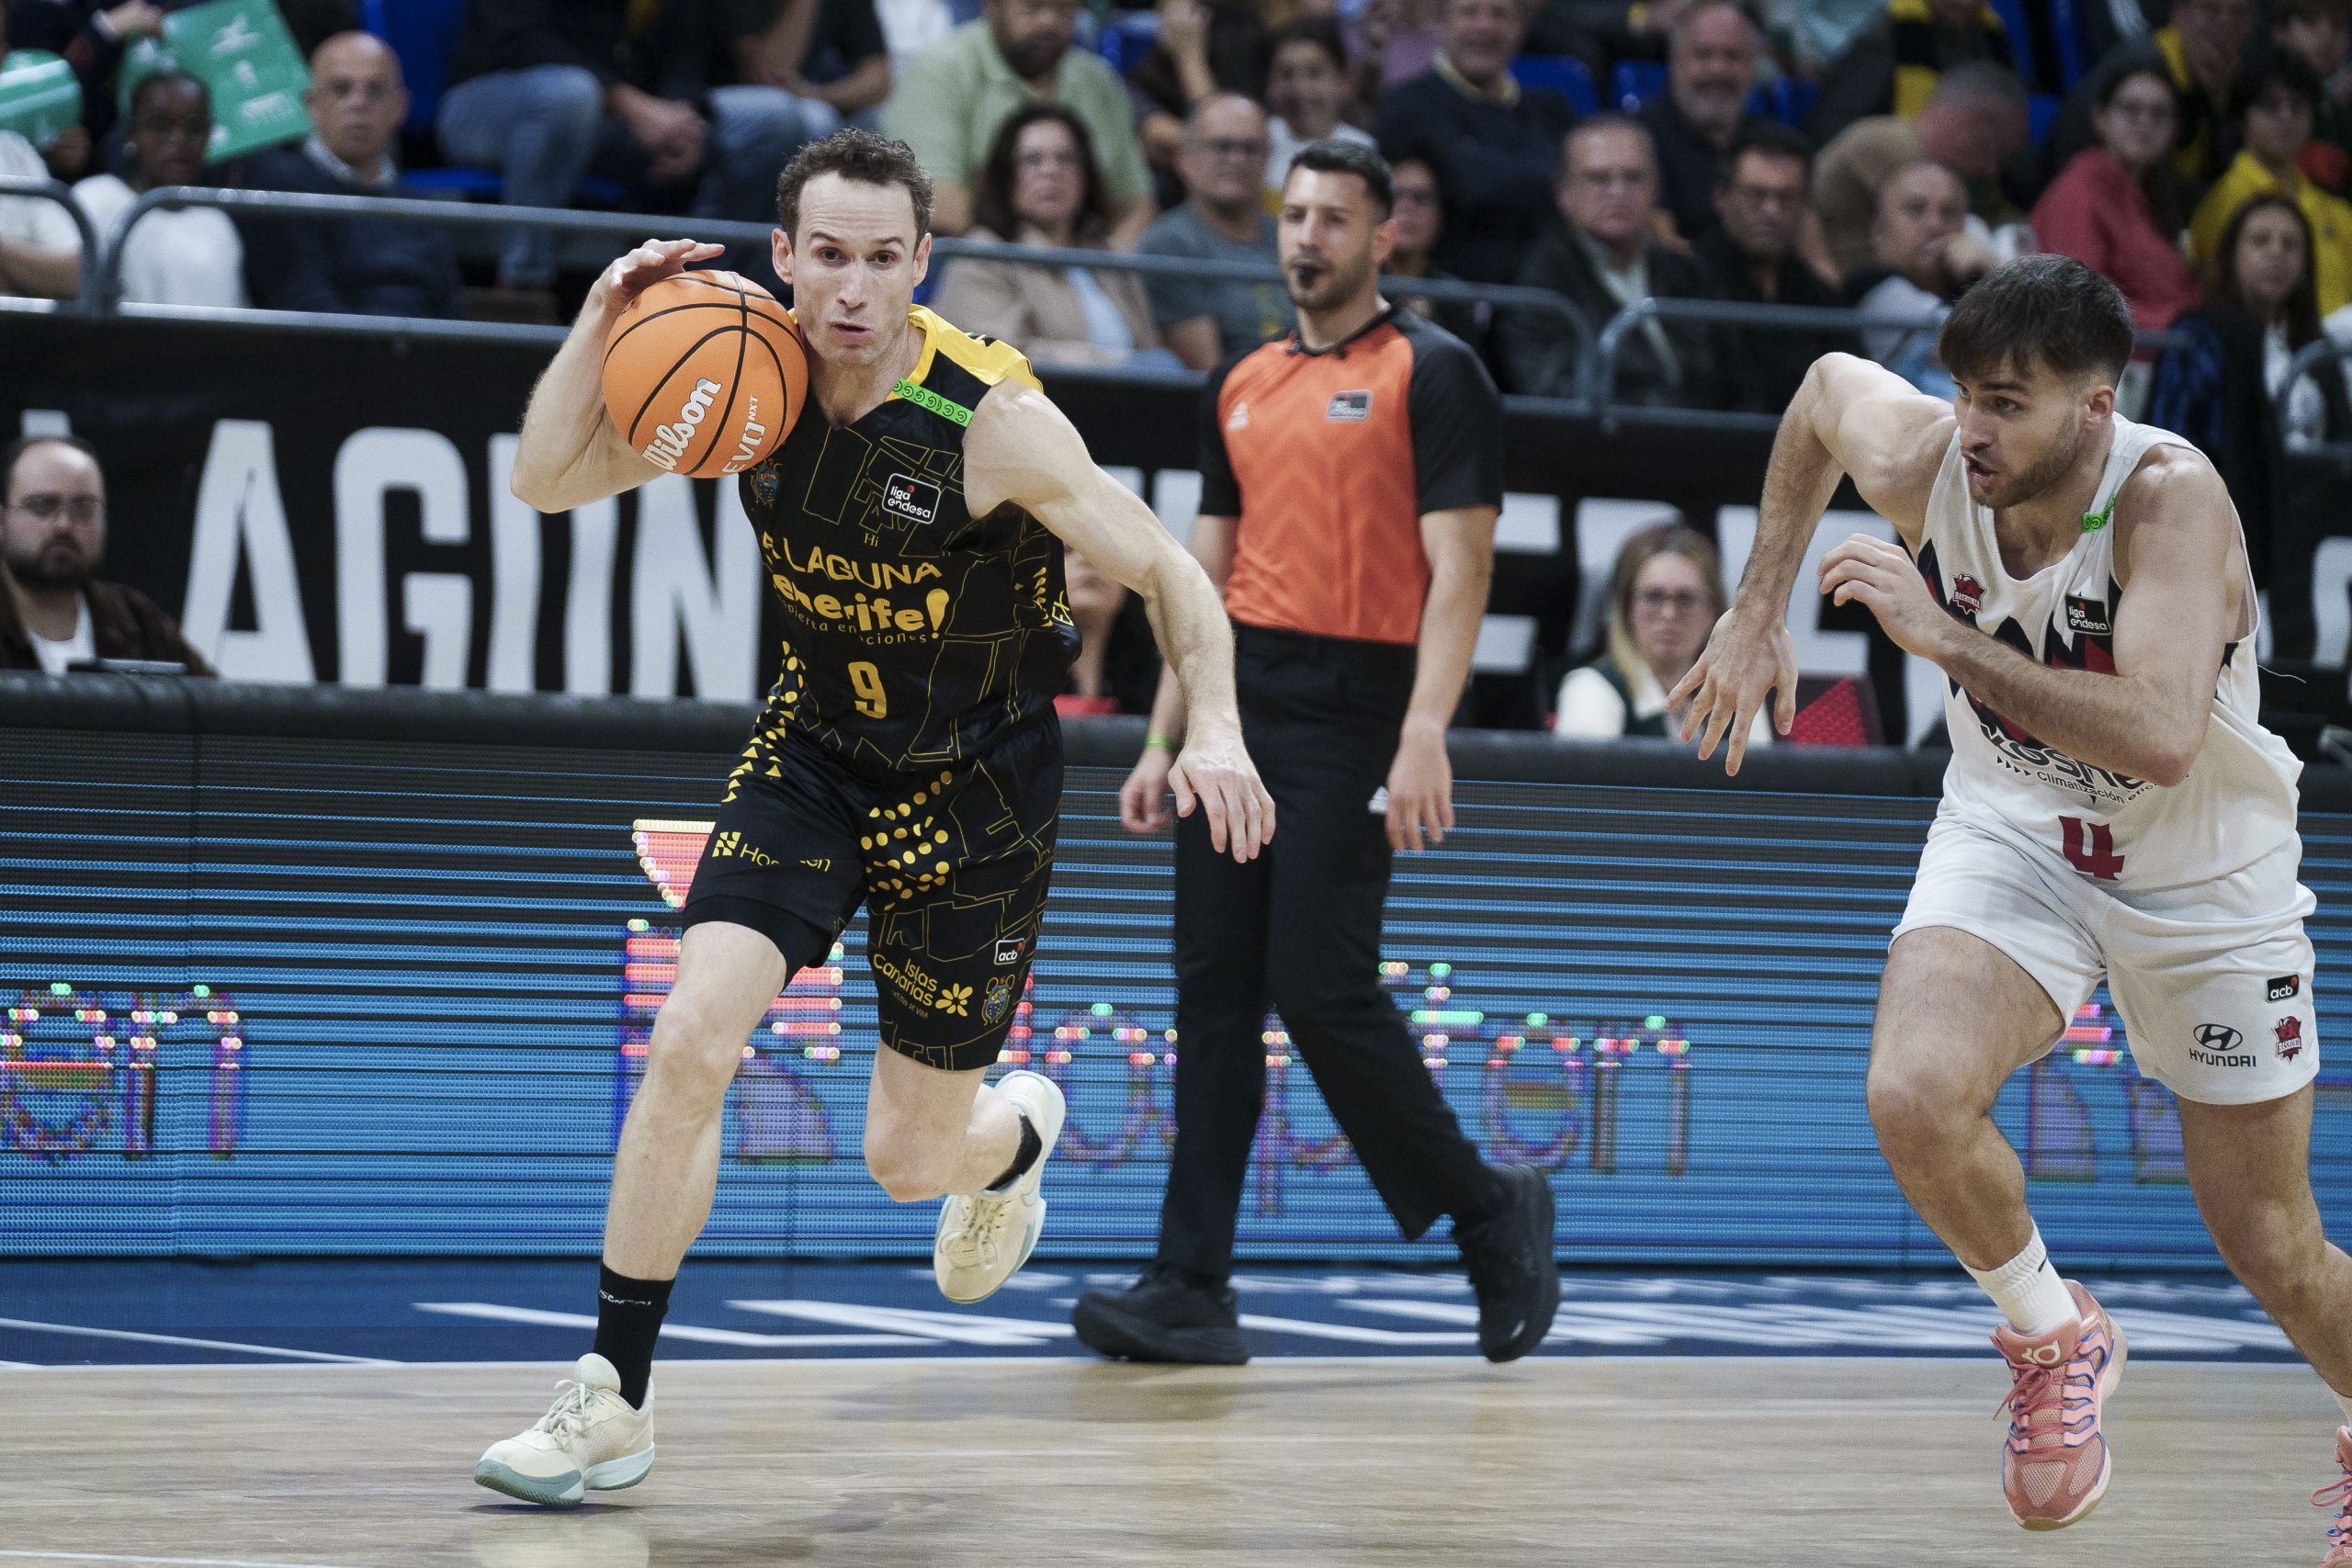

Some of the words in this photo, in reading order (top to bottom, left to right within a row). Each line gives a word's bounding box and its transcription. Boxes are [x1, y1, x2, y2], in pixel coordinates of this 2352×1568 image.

[642, 378, 722, 471] Wilson
[890, 486, 911, 501] liga
[888, 497, 932, 519] endesa
[784, 536, 943, 590] LAGUNA
[2069, 604, 2086, 618] liga
[2070, 617, 2107, 630] endesa
[847, 660, 888, 719] 9
[2036, 770, 2125, 805] Climatización
[2058, 815, 2125, 881] 4
[999, 950, 1018, 963] acb
[873, 953, 933, 1007] Canarias
[904, 958, 938, 992] Islas
[2270, 985, 2293, 999] acb
[2189, 1047, 2256, 1067] HYUNDAI
